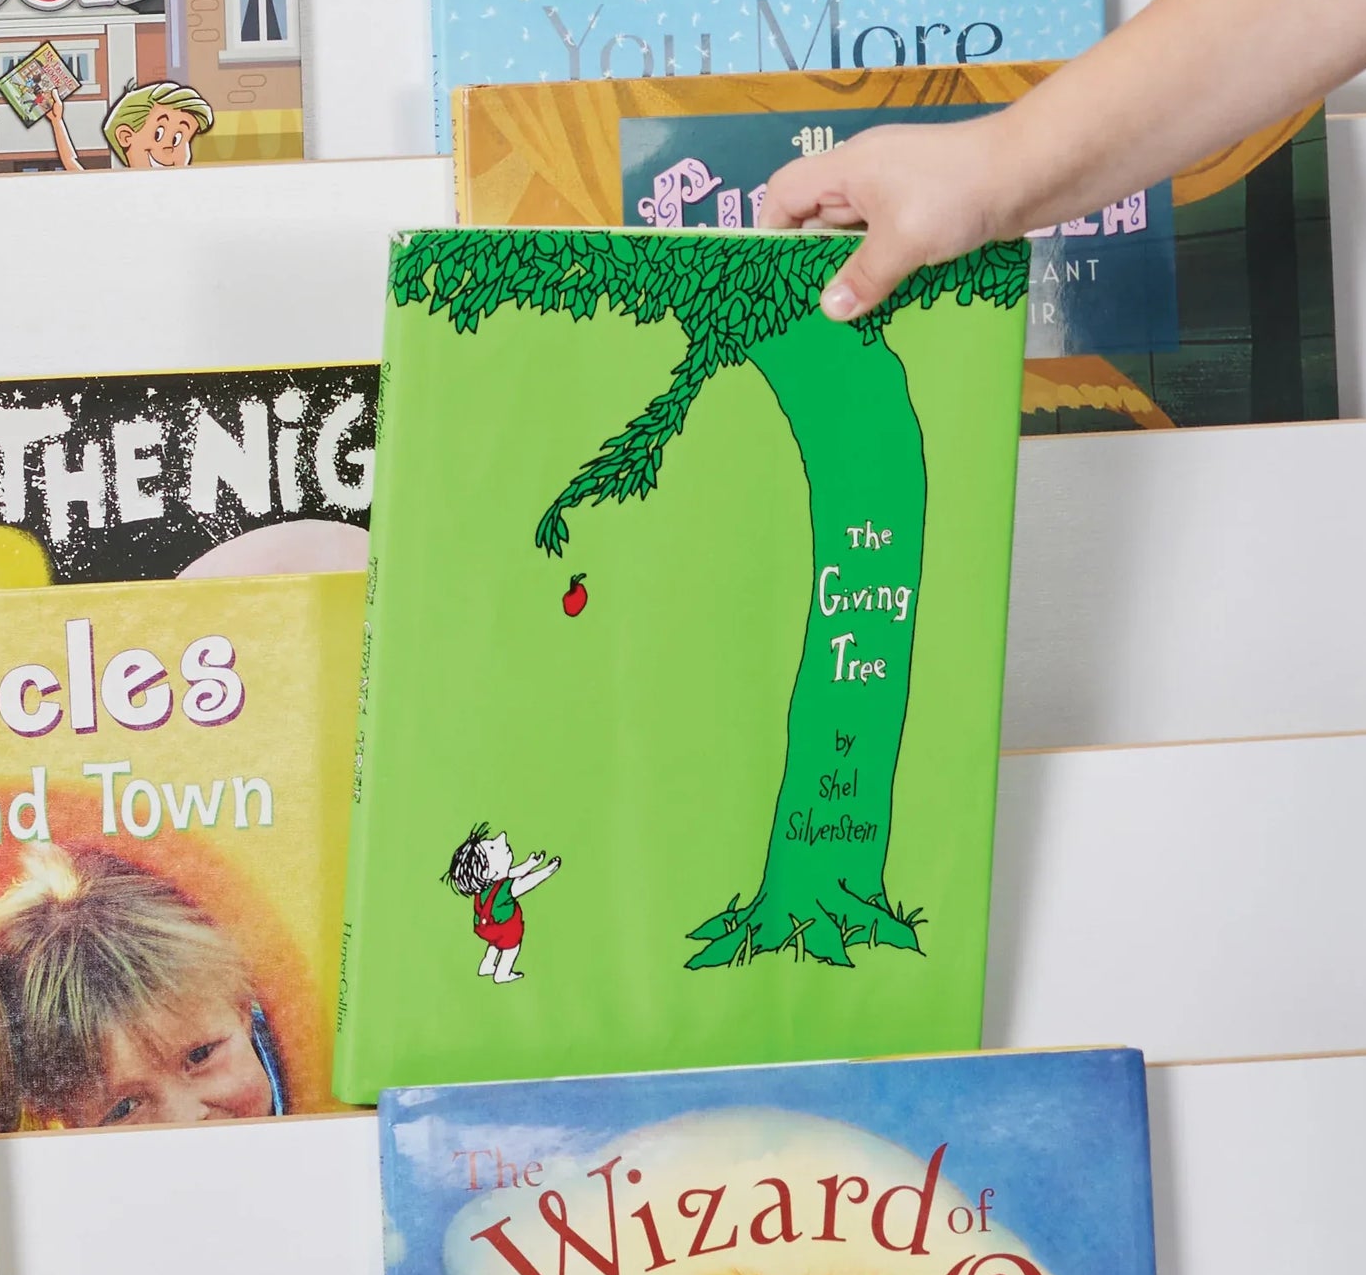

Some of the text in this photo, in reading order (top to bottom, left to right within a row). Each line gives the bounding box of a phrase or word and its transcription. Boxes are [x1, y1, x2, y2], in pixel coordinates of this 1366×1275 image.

[542, 3, 713, 82] You
[845, 520, 893, 550] The
[818, 566, 913, 622] Giving
[830, 633, 888, 686] Tree
[834, 730, 857, 757] by
[82, 759, 274, 842] Town
[818, 769, 858, 800] Shel
[337, 921, 353, 1034] HarperCollins
[452, 1147, 544, 1194] The
[946, 1188, 995, 1236] of
